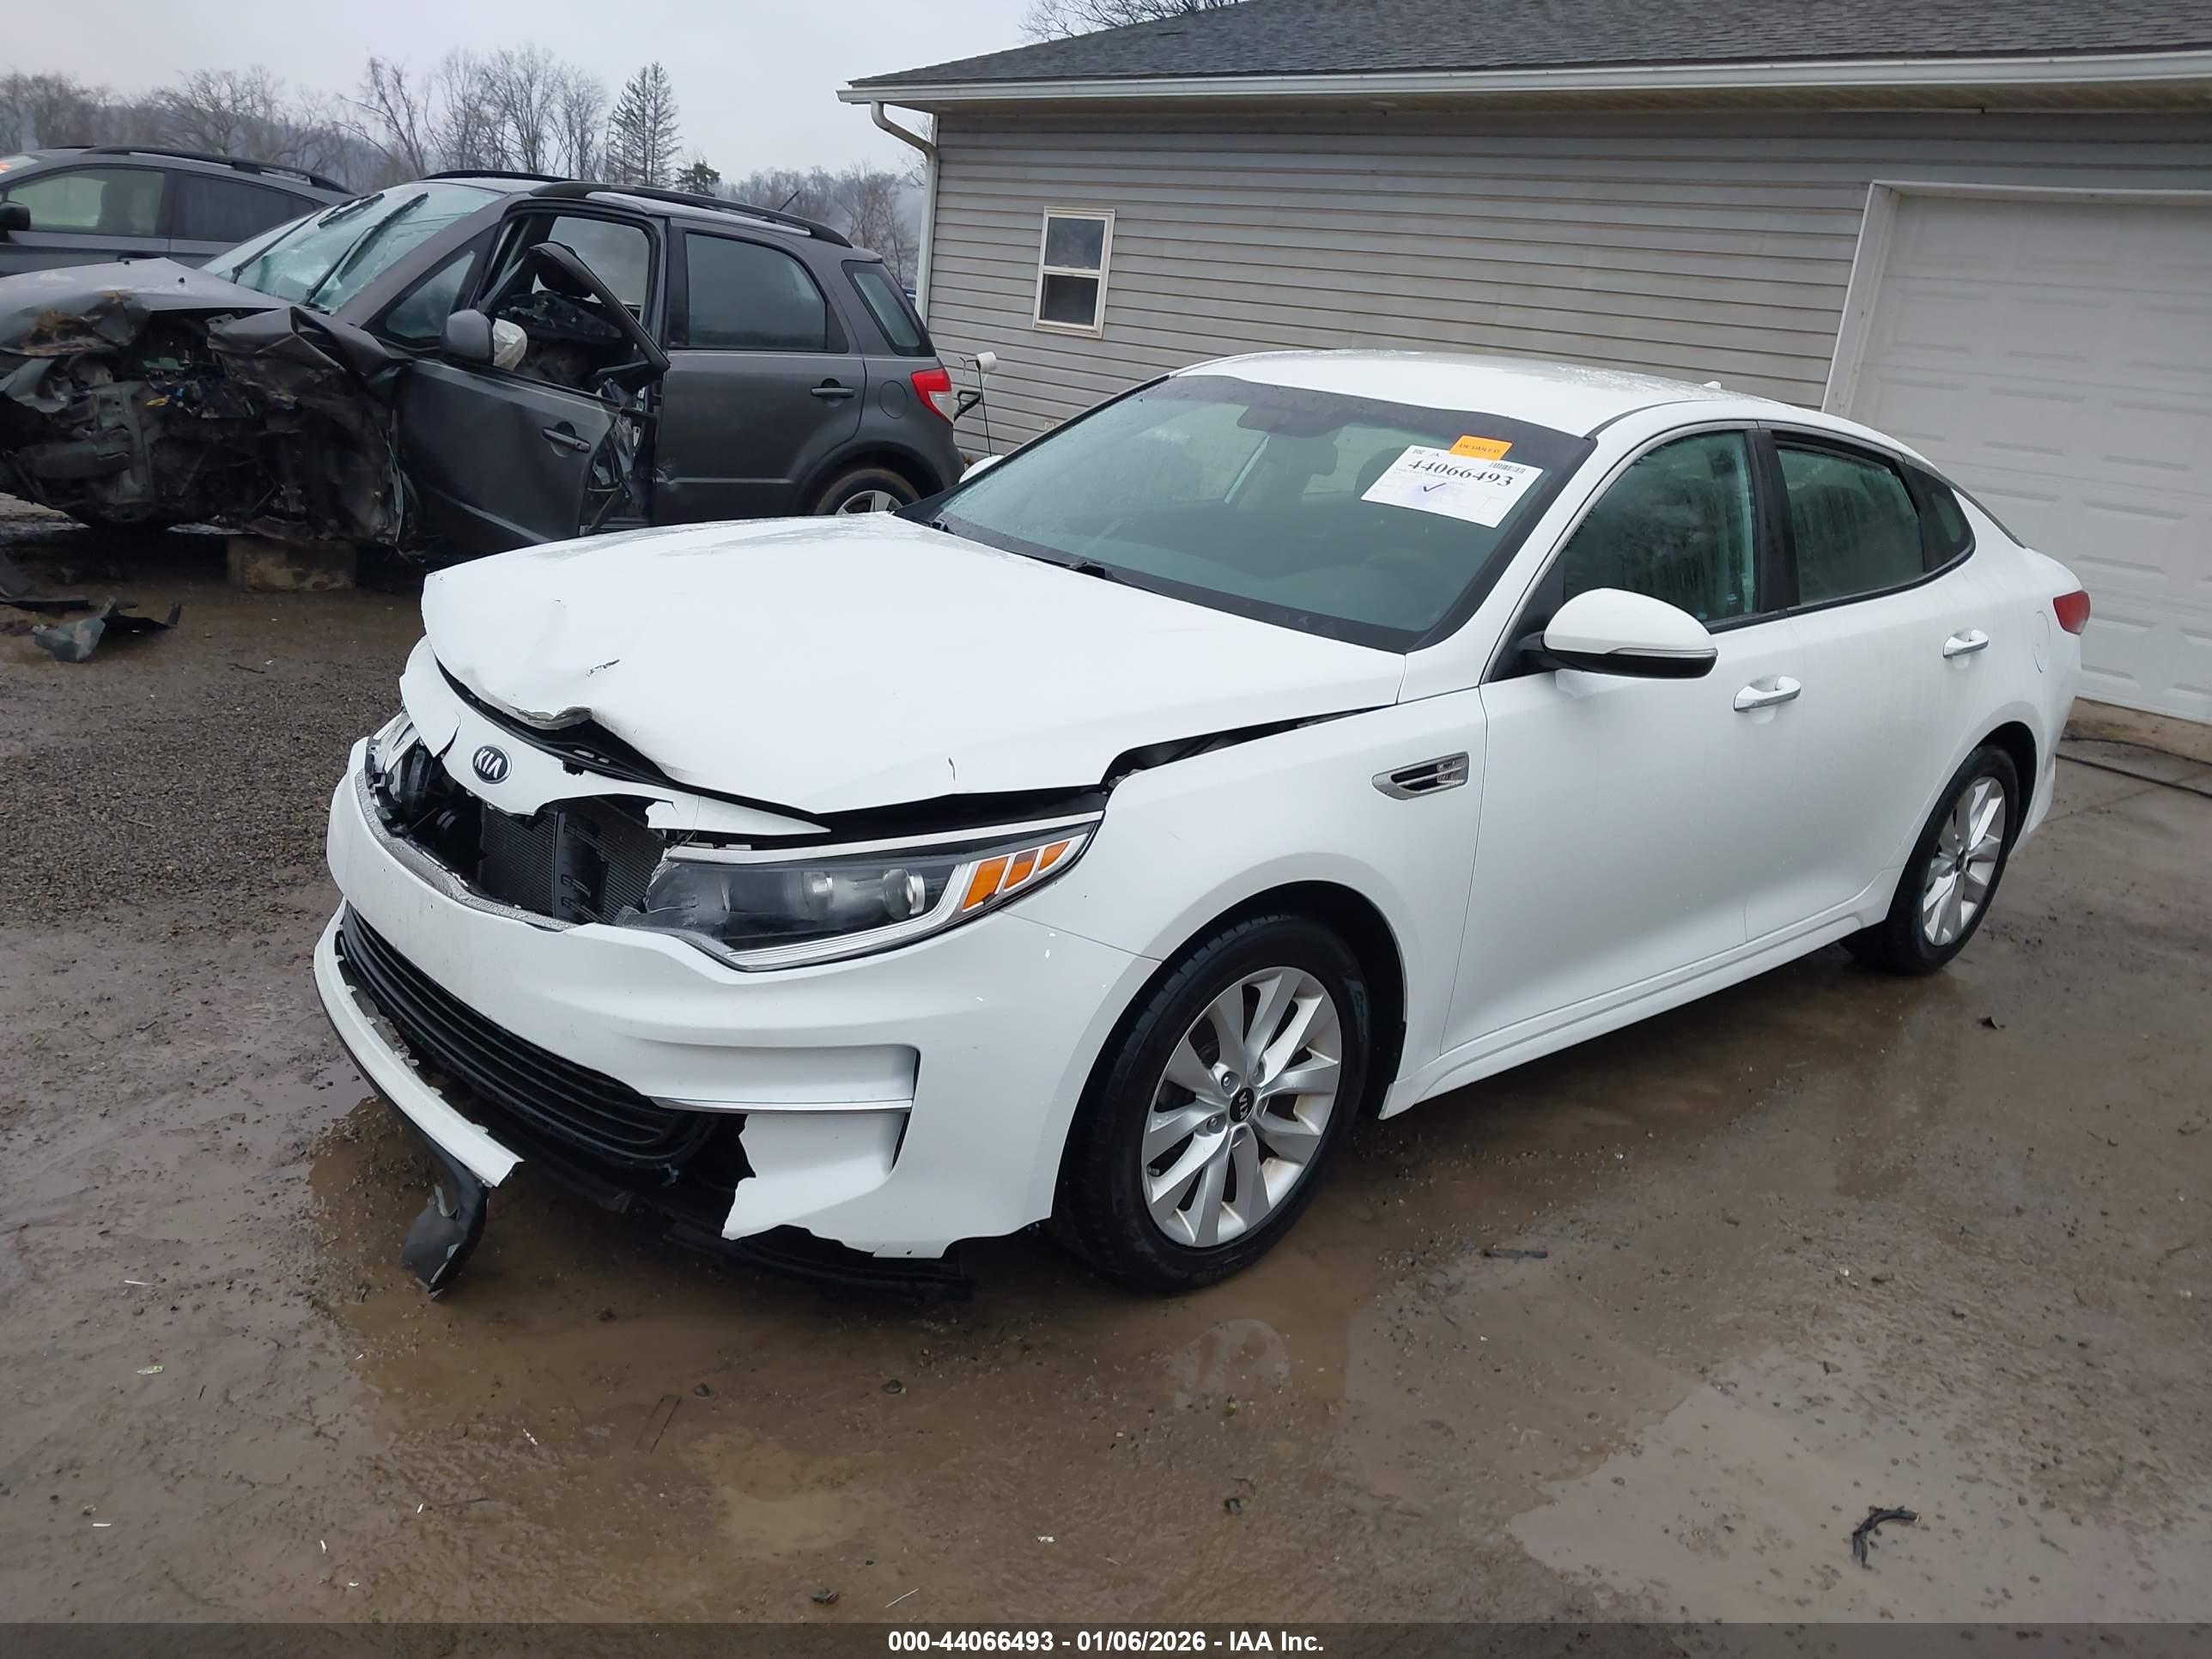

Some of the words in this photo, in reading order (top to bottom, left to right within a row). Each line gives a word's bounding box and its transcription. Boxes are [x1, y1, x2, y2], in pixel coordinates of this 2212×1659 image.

[1407, 459, 1514, 487] 44066493
[473, 748, 503, 780] KIA
[1238, 1091, 1249, 1121] KIA
